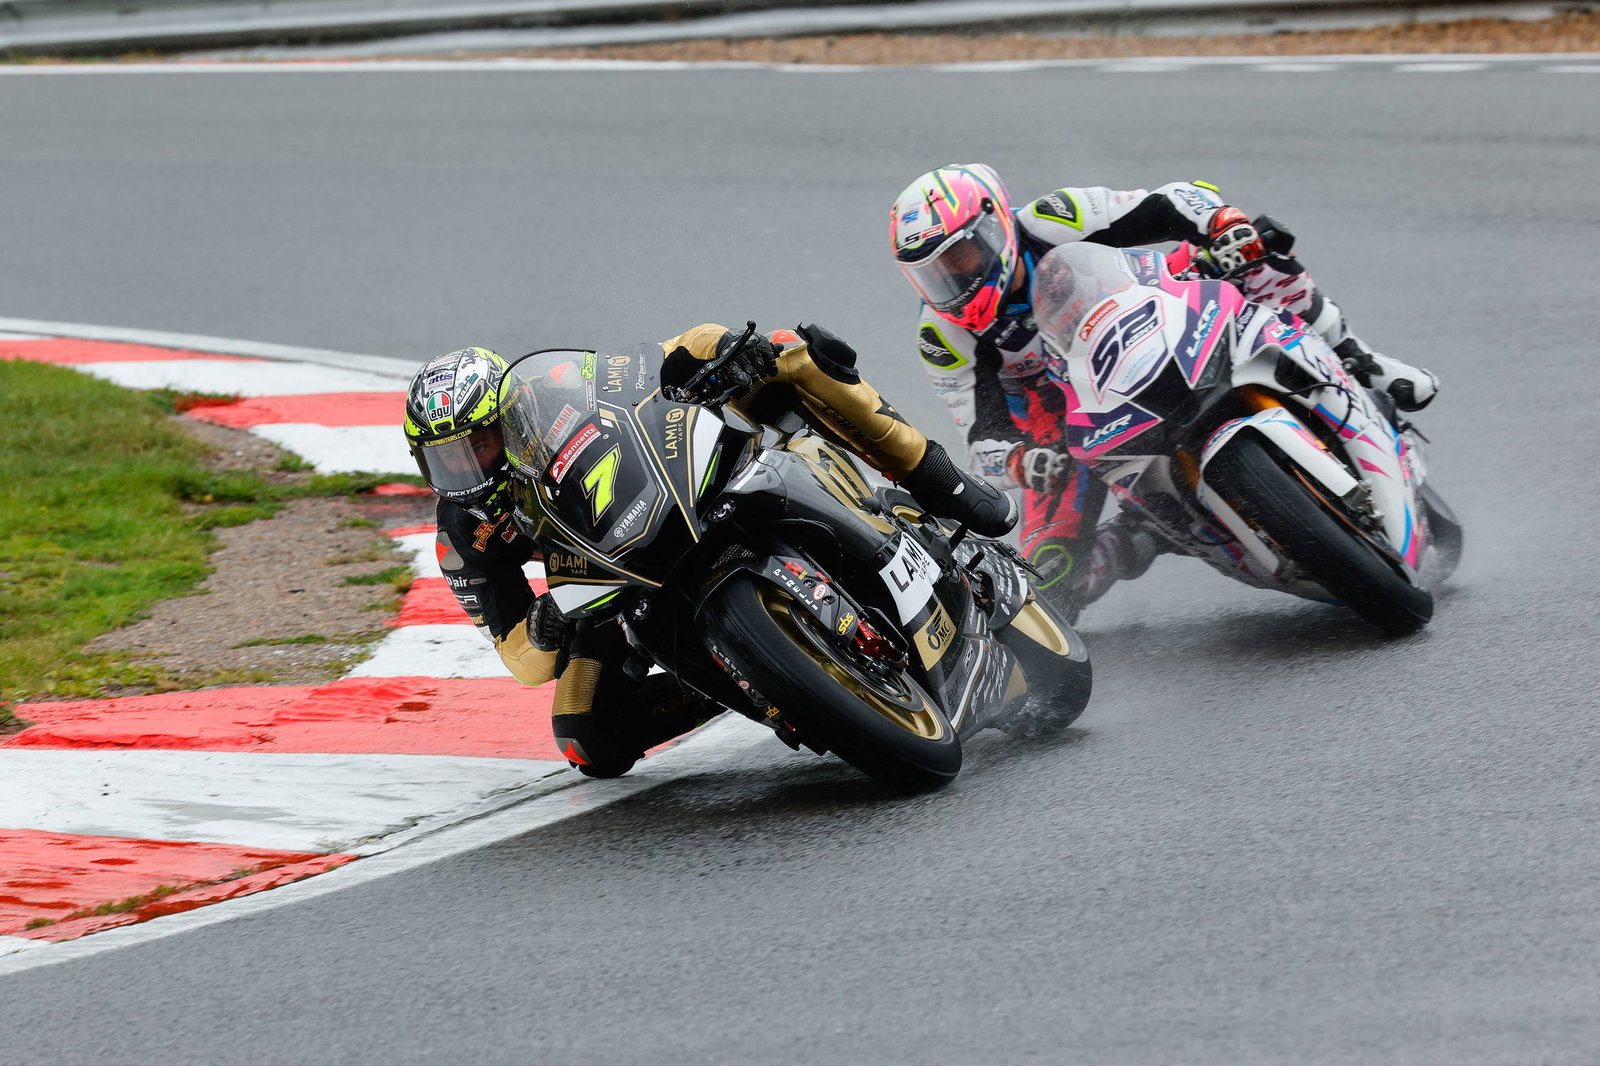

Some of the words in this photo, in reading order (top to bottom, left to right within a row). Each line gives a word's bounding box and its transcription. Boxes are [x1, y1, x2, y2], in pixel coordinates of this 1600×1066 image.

[1091, 300, 1158, 392] 52
[430, 405, 450, 420] agv
[562, 426, 596, 461] Bennetts
[665, 423, 678, 460] LAMI
[580, 444, 621, 526] 7
[619, 500, 647, 531] YAMAHA
[560, 557, 588, 568] LAMI
[773, 568, 818, 611] PIRELLI
[838, 612, 855, 636] sbs
